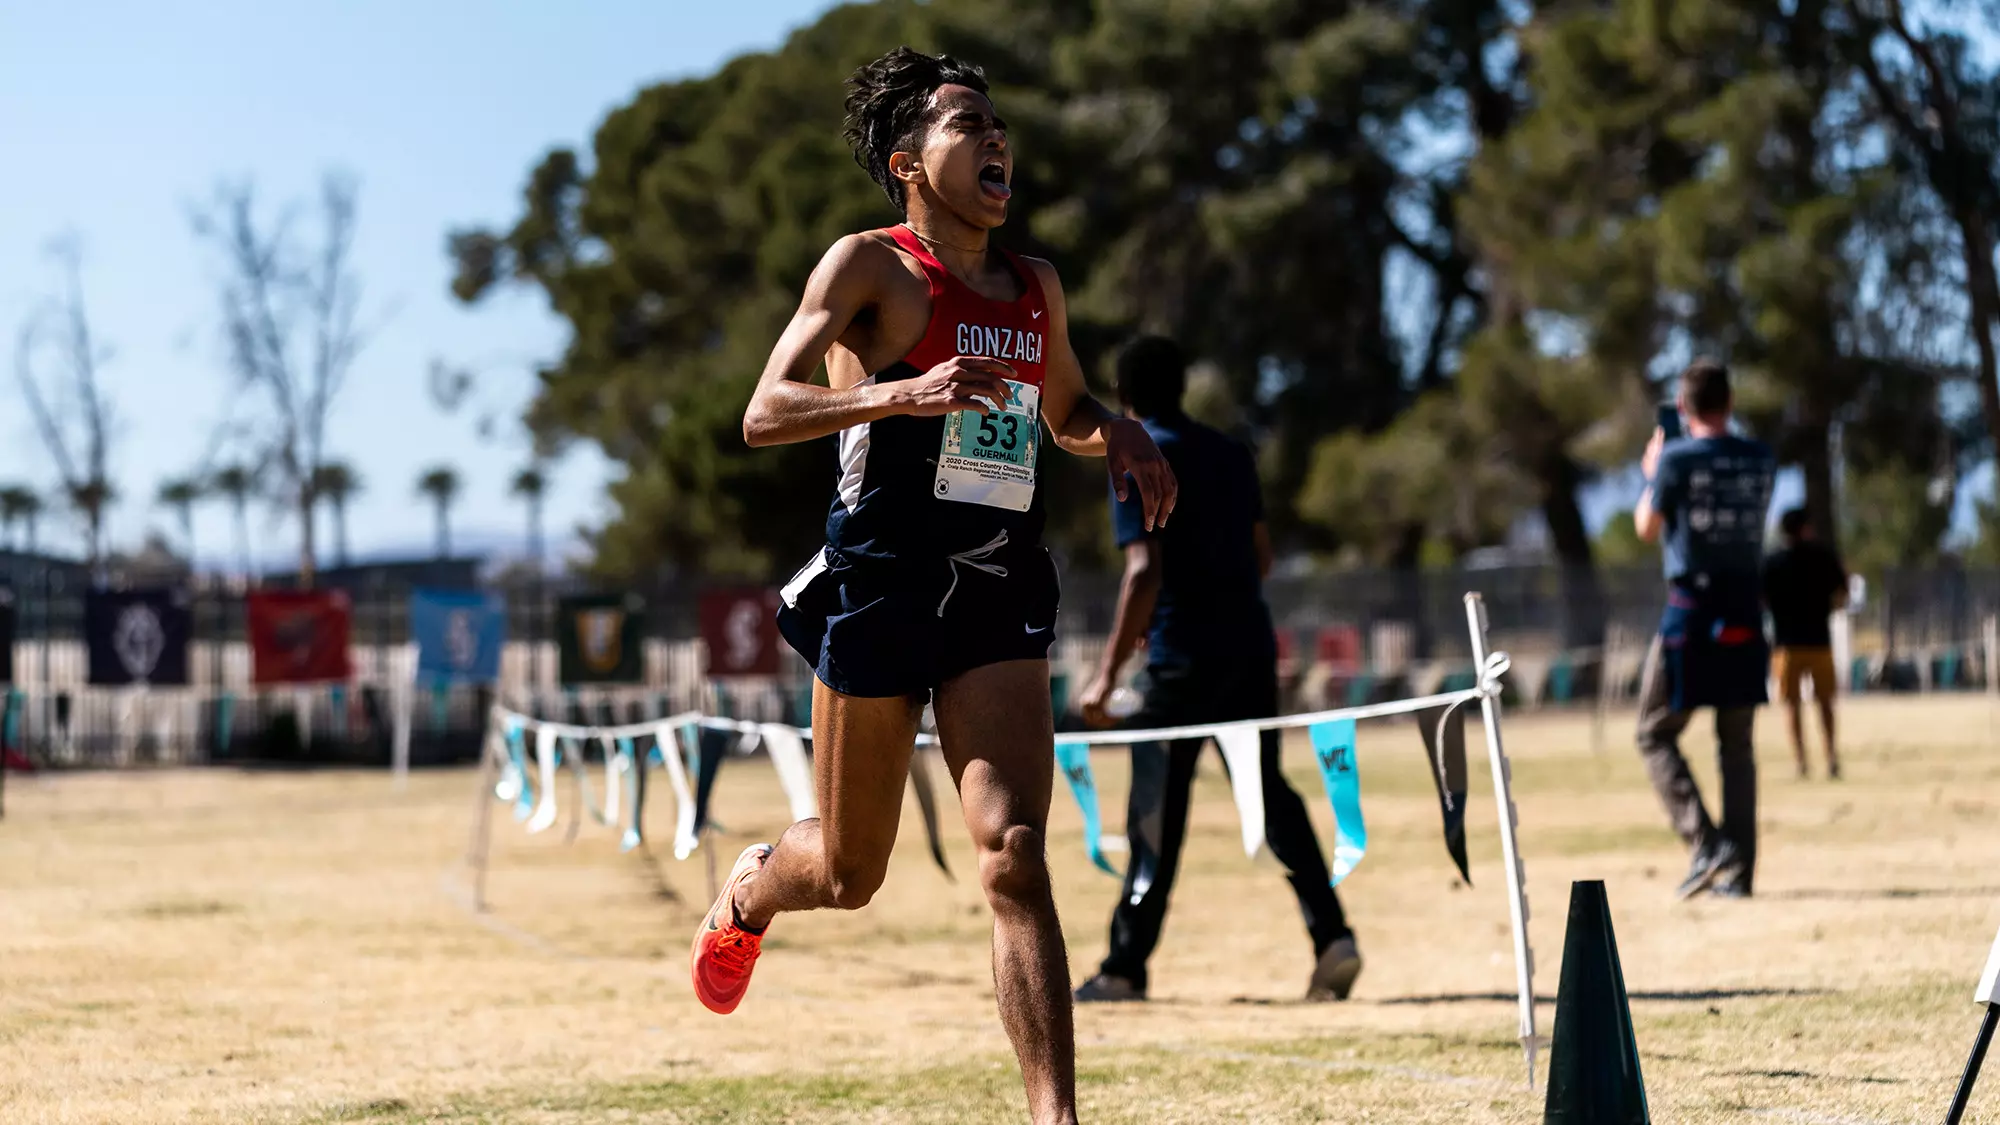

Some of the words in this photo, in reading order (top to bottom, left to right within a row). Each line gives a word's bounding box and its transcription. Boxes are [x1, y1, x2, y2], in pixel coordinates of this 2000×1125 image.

[956, 323, 1042, 364] GONZAGA
[976, 412, 1018, 450] 53
[945, 457, 962, 465] 2020
[962, 459, 979, 468] Cross
[979, 461, 1002, 471] Country
[972, 448, 1018, 462] GUERMALI
